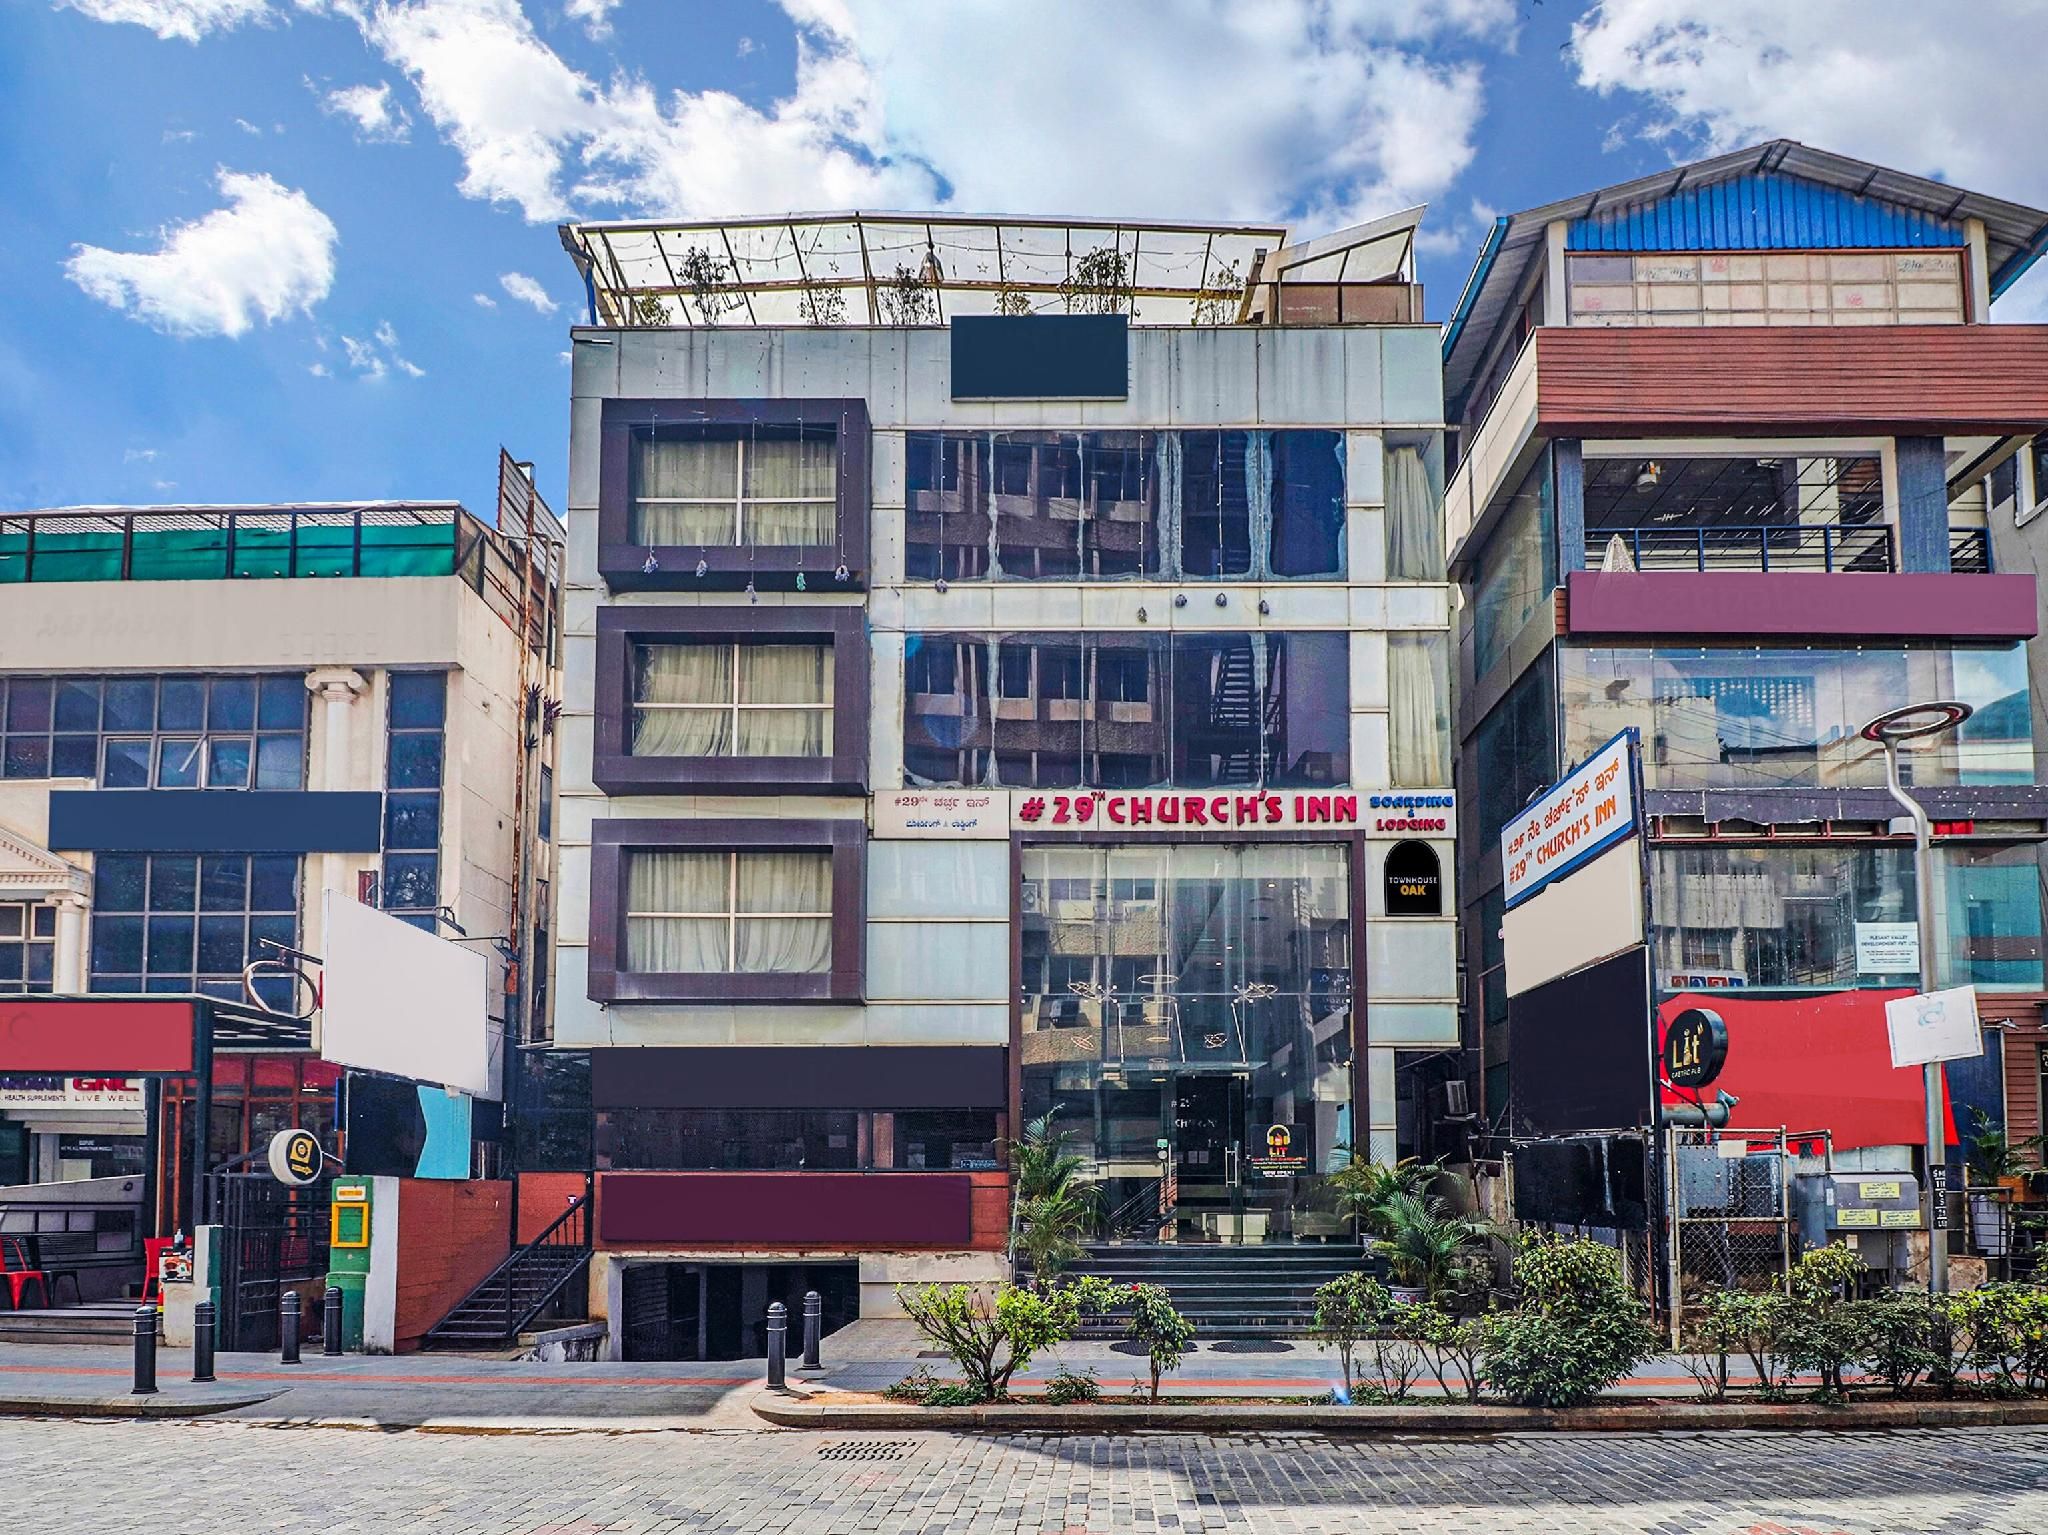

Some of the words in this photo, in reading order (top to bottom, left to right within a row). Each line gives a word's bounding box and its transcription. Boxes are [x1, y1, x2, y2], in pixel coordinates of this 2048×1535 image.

[1594, 757, 1619, 792] ಇನ್
[1107, 790, 1283, 826] CHURCH'S
[1294, 795, 1357, 823] INN
[1370, 796, 1453, 808] BOARDING
[1376, 818, 1446, 832] LODGING
[1536, 813, 1591, 865] CHURCH'S
[1595, 795, 1617, 828] INN
[1388, 876, 1438, 884] TOWNHOUSE
[1400, 884, 1427, 896] OAK
[73, 1077, 139, 1092] GNC
